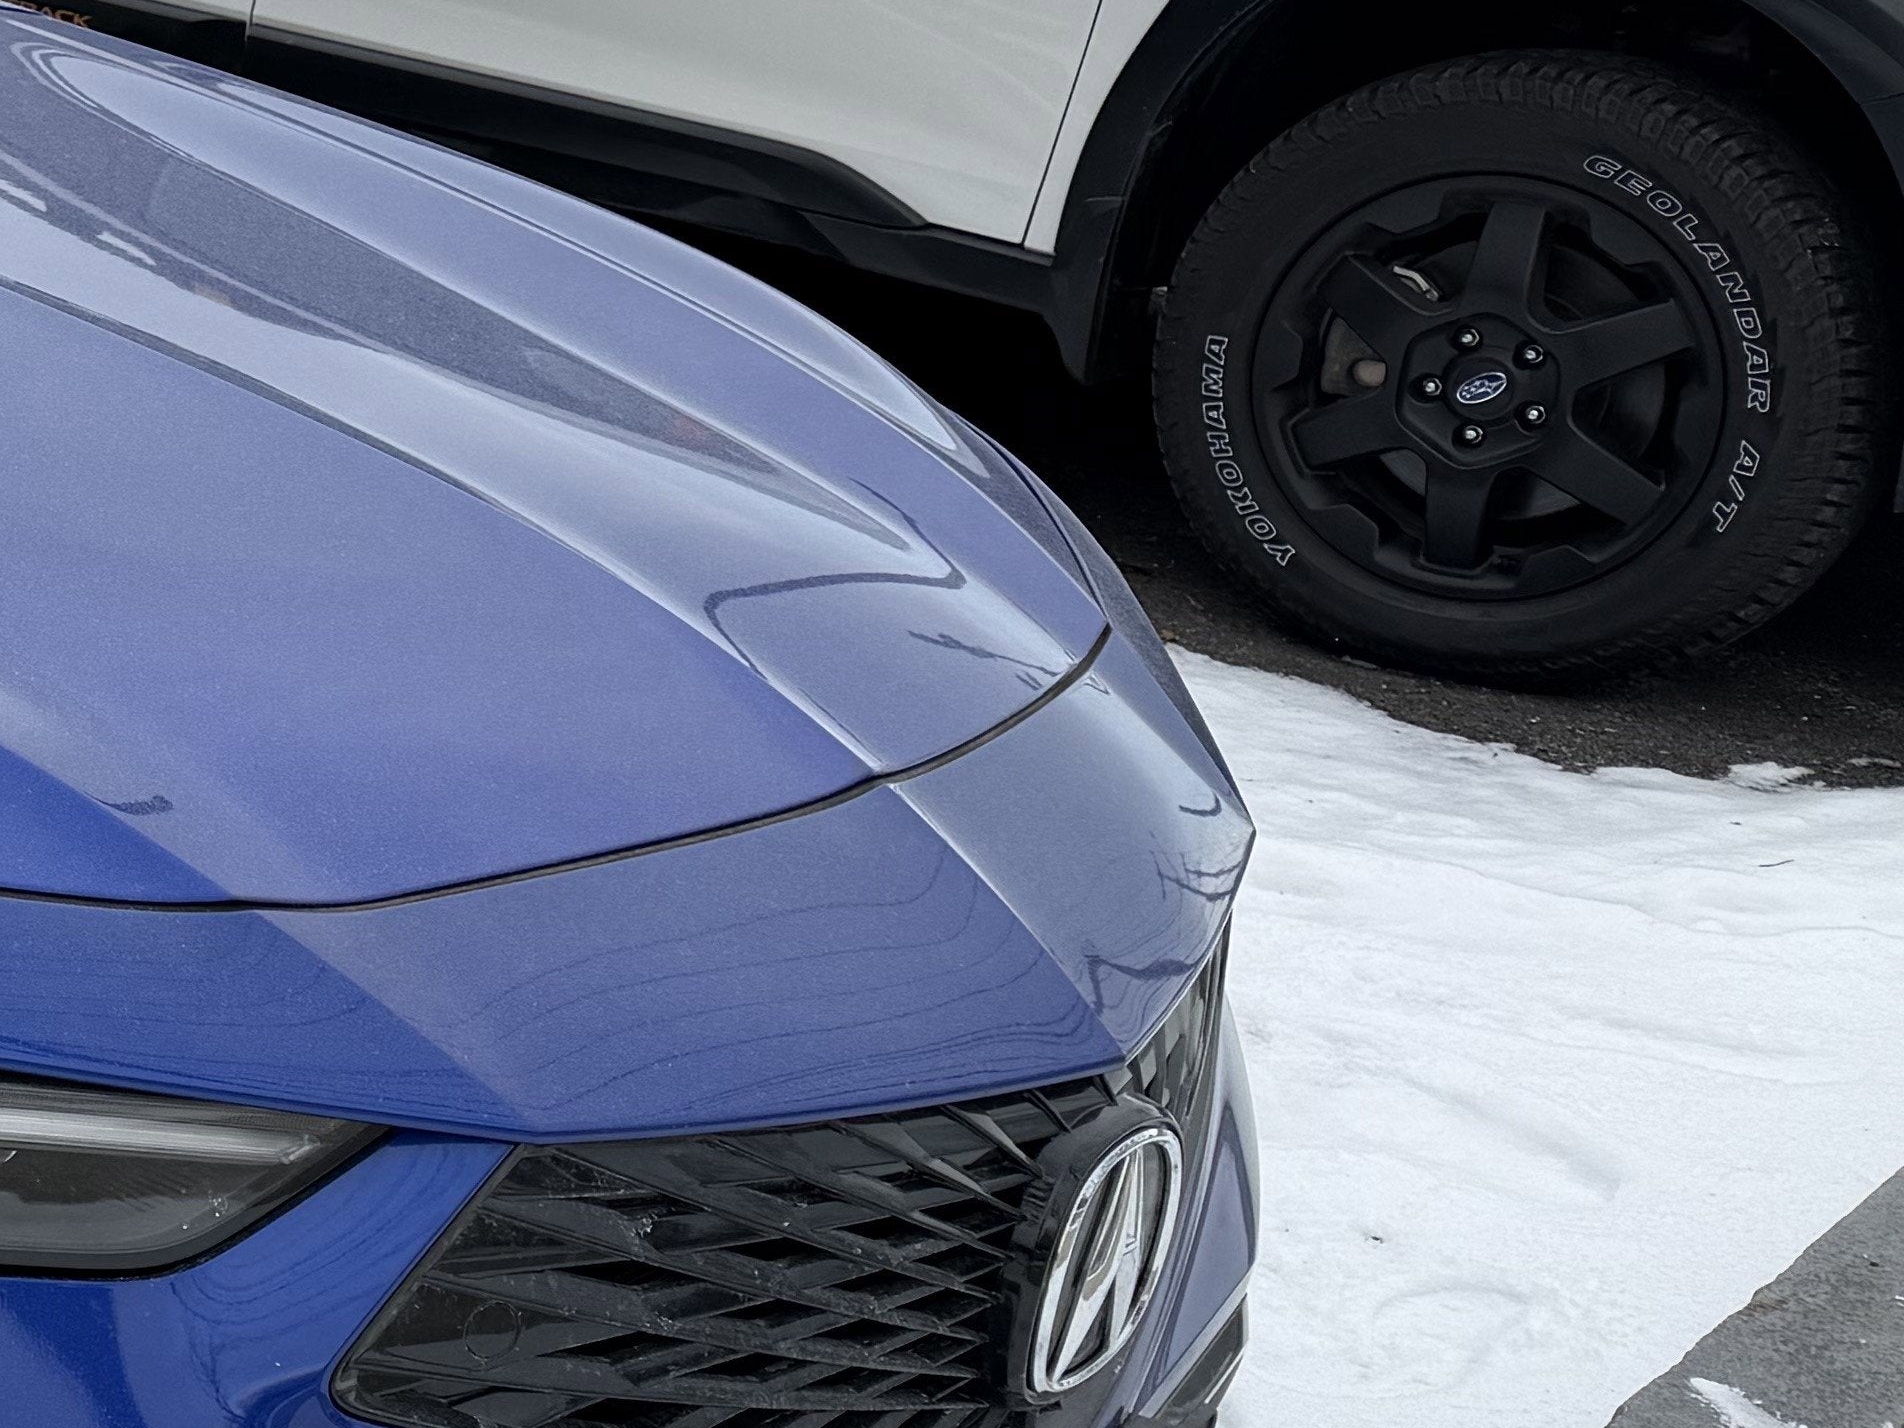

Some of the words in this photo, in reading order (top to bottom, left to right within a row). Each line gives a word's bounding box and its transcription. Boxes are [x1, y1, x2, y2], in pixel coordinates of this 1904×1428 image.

[1201, 335, 1296, 566] YOKOHAMA
[1583, 155, 1771, 413] GEOLANDAR
[1712, 440, 1760, 533] A/T
